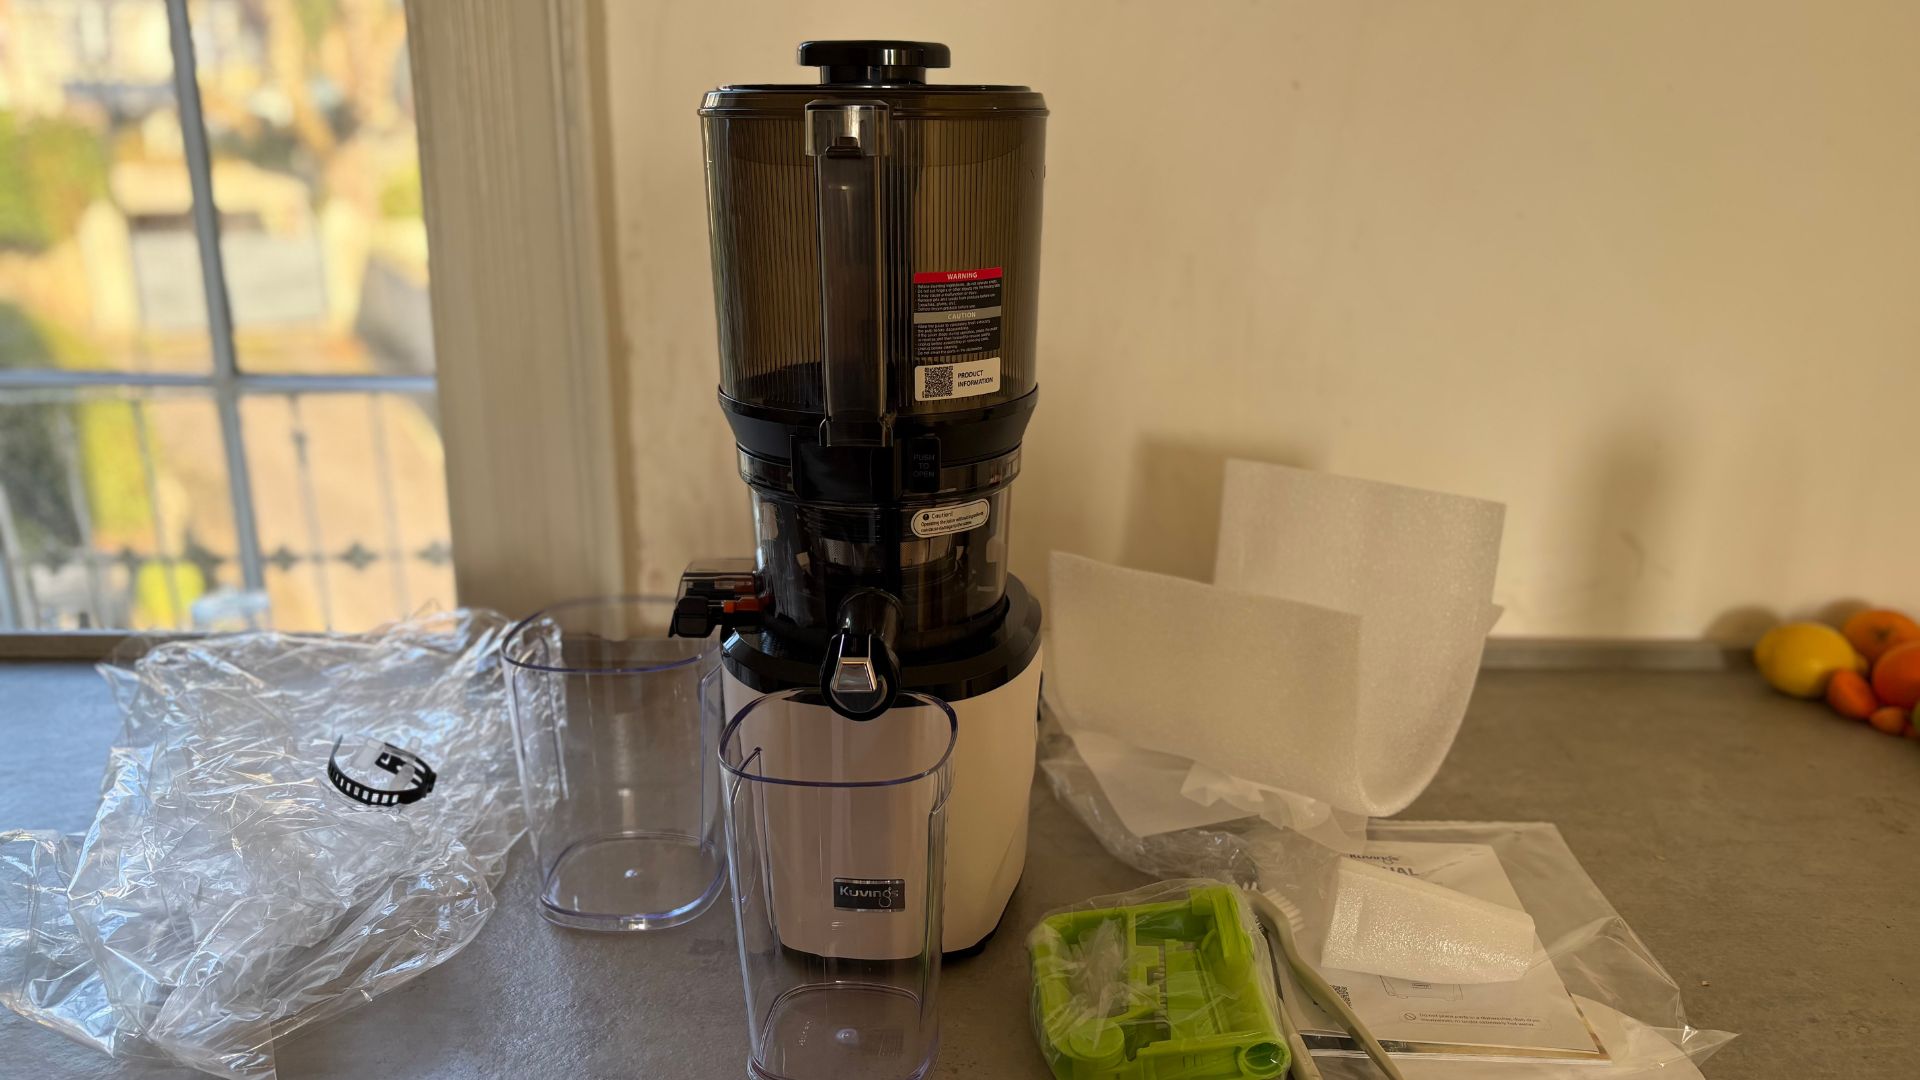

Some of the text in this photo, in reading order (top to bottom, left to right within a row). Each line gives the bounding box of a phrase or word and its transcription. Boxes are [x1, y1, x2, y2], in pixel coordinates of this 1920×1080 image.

[947, 272, 978, 280] WARNING
[947, 312, 976, 320] CAUTION
[957, 370, 984, 379] PRODUCT
[957, 377, 993, 388] INFORMATION
[913, 453, 936, 461] PUSH
[918, 462, 930, 470] TO
[912, 470, 935, 478] OPEN
